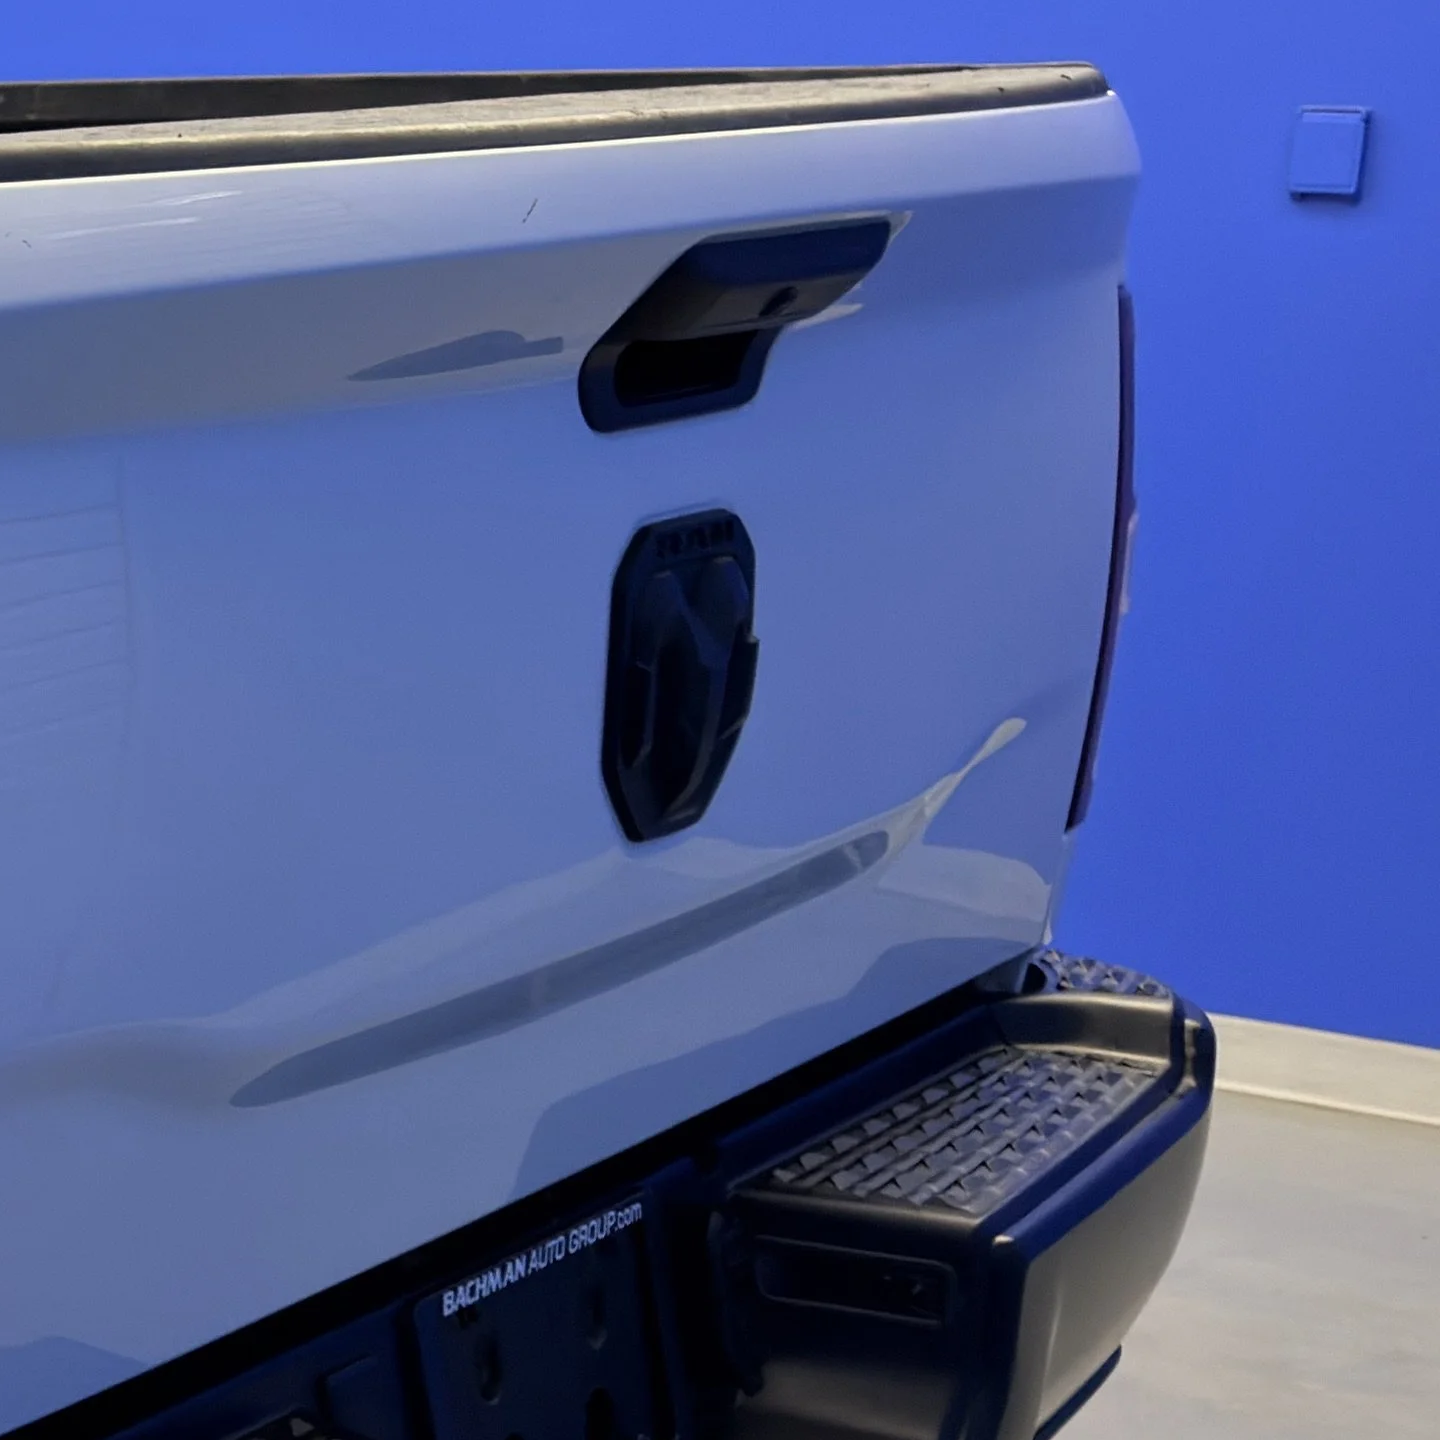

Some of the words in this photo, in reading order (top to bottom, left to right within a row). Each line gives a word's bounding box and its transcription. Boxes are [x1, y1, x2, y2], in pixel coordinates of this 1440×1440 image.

[441, 1255, 527, 1318] BACHMAN
[527, 1235, 567, 1275] AUTO
[568, 1201, 643, 1255] GROUP.com
